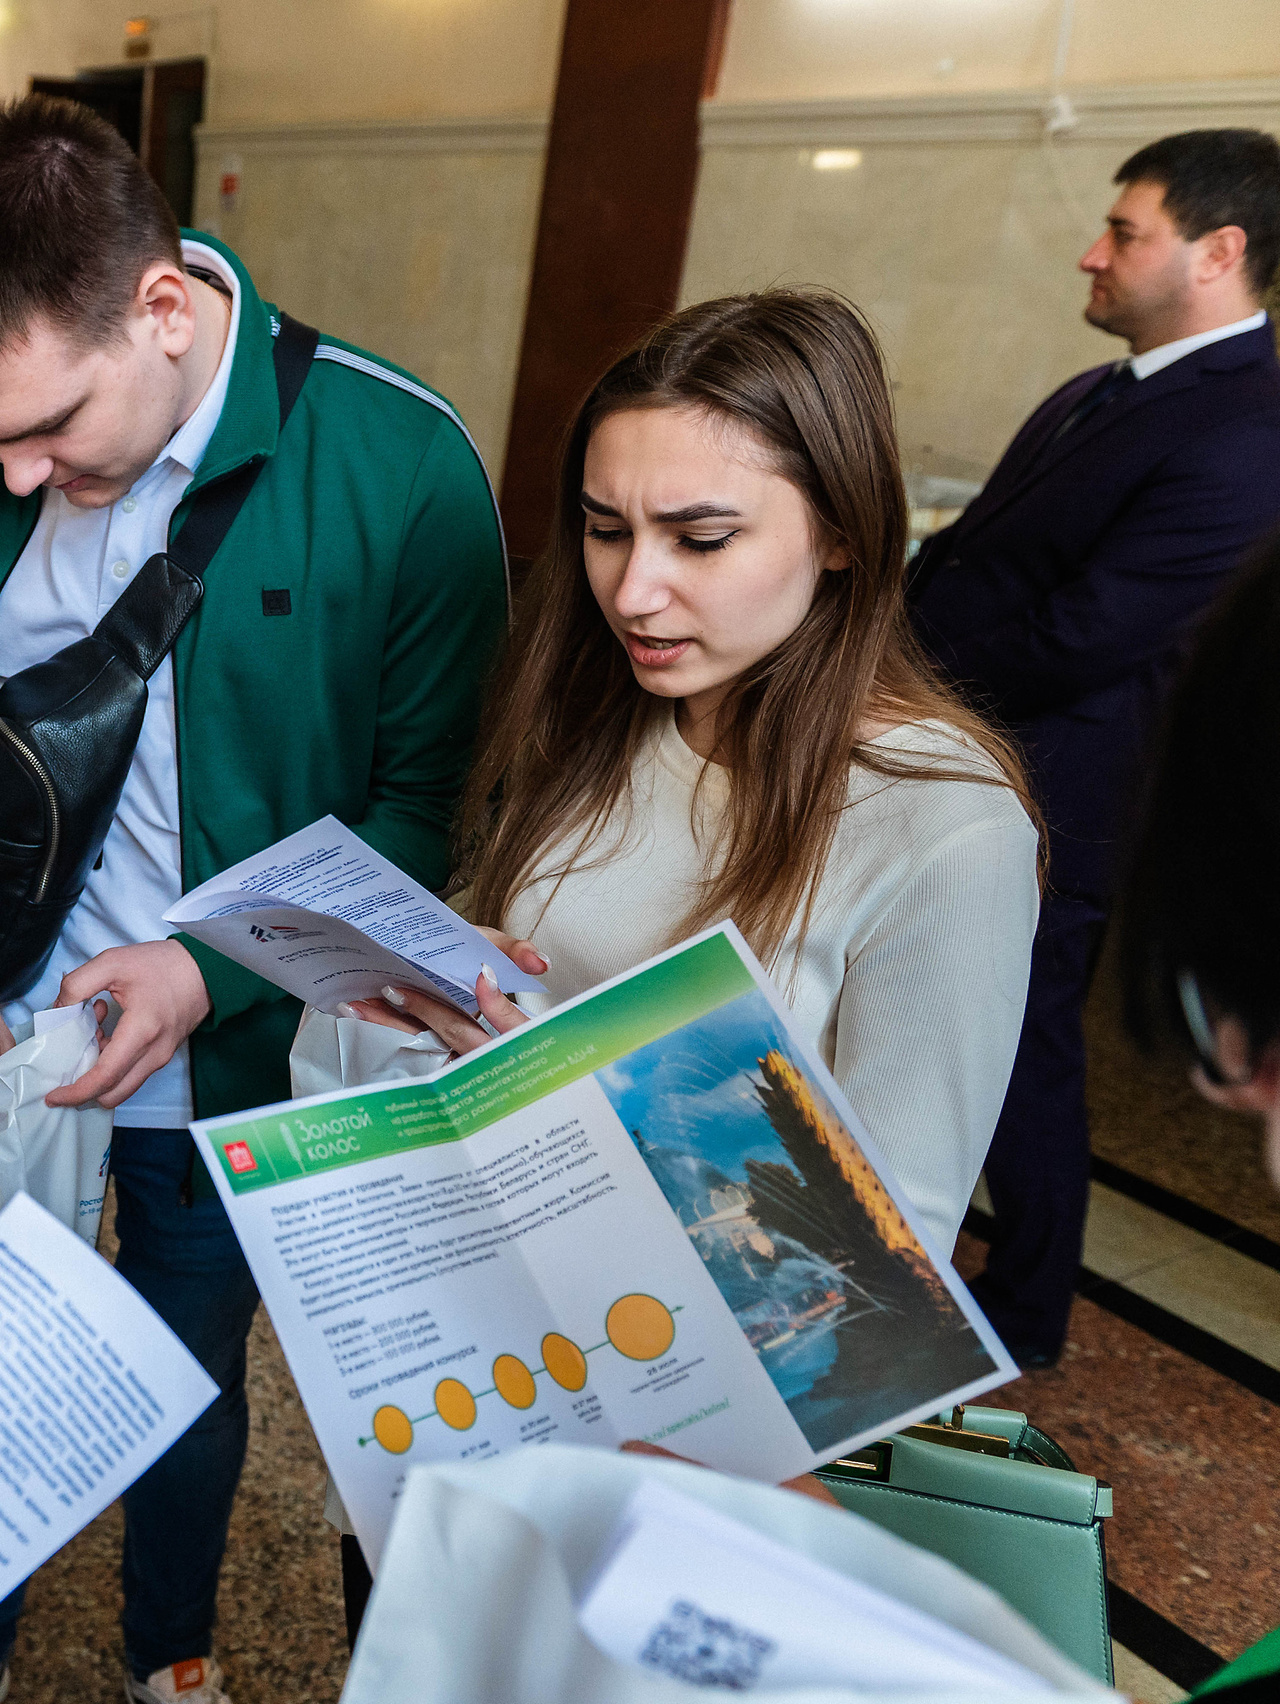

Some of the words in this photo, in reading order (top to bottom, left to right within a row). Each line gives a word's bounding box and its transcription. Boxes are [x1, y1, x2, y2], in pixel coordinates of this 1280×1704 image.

[449, 1055, 518, 1099] архитектурный
[518, 1035, 557, 1062] конкурс
[474, 1056, 548, 1104] архитектурного
[511, 1061, 568, 1097] территории
[567, 1043, 599, 1067] ВДНХ
[475, 1144, 530, 1175] специалистов
[545, 1118, 580, 1140] области
[499, 1168, 538, 1190] Беларусь
[545, 1151, 570, 1167] стран
[570, 1138, 593, 1154] СНГ.
[528, 1128, 586, 1162] обучающихся
[506, 1180, 540, 1201] которых
[541, 1168, 564, 1184] могут
[565, 1150, 599, 1171] входить
[544, 1194, 570, 1210] жюри.
[569, 1172, 611, 1196] Комиссия
[556, 1185, 618, 1217] масштабность,
[646, 1364, 658, 1377] 28
[658, 1358, 678, 1371] июля
[642, 1397, 732, 1443] h.ru/specials/kolos/
